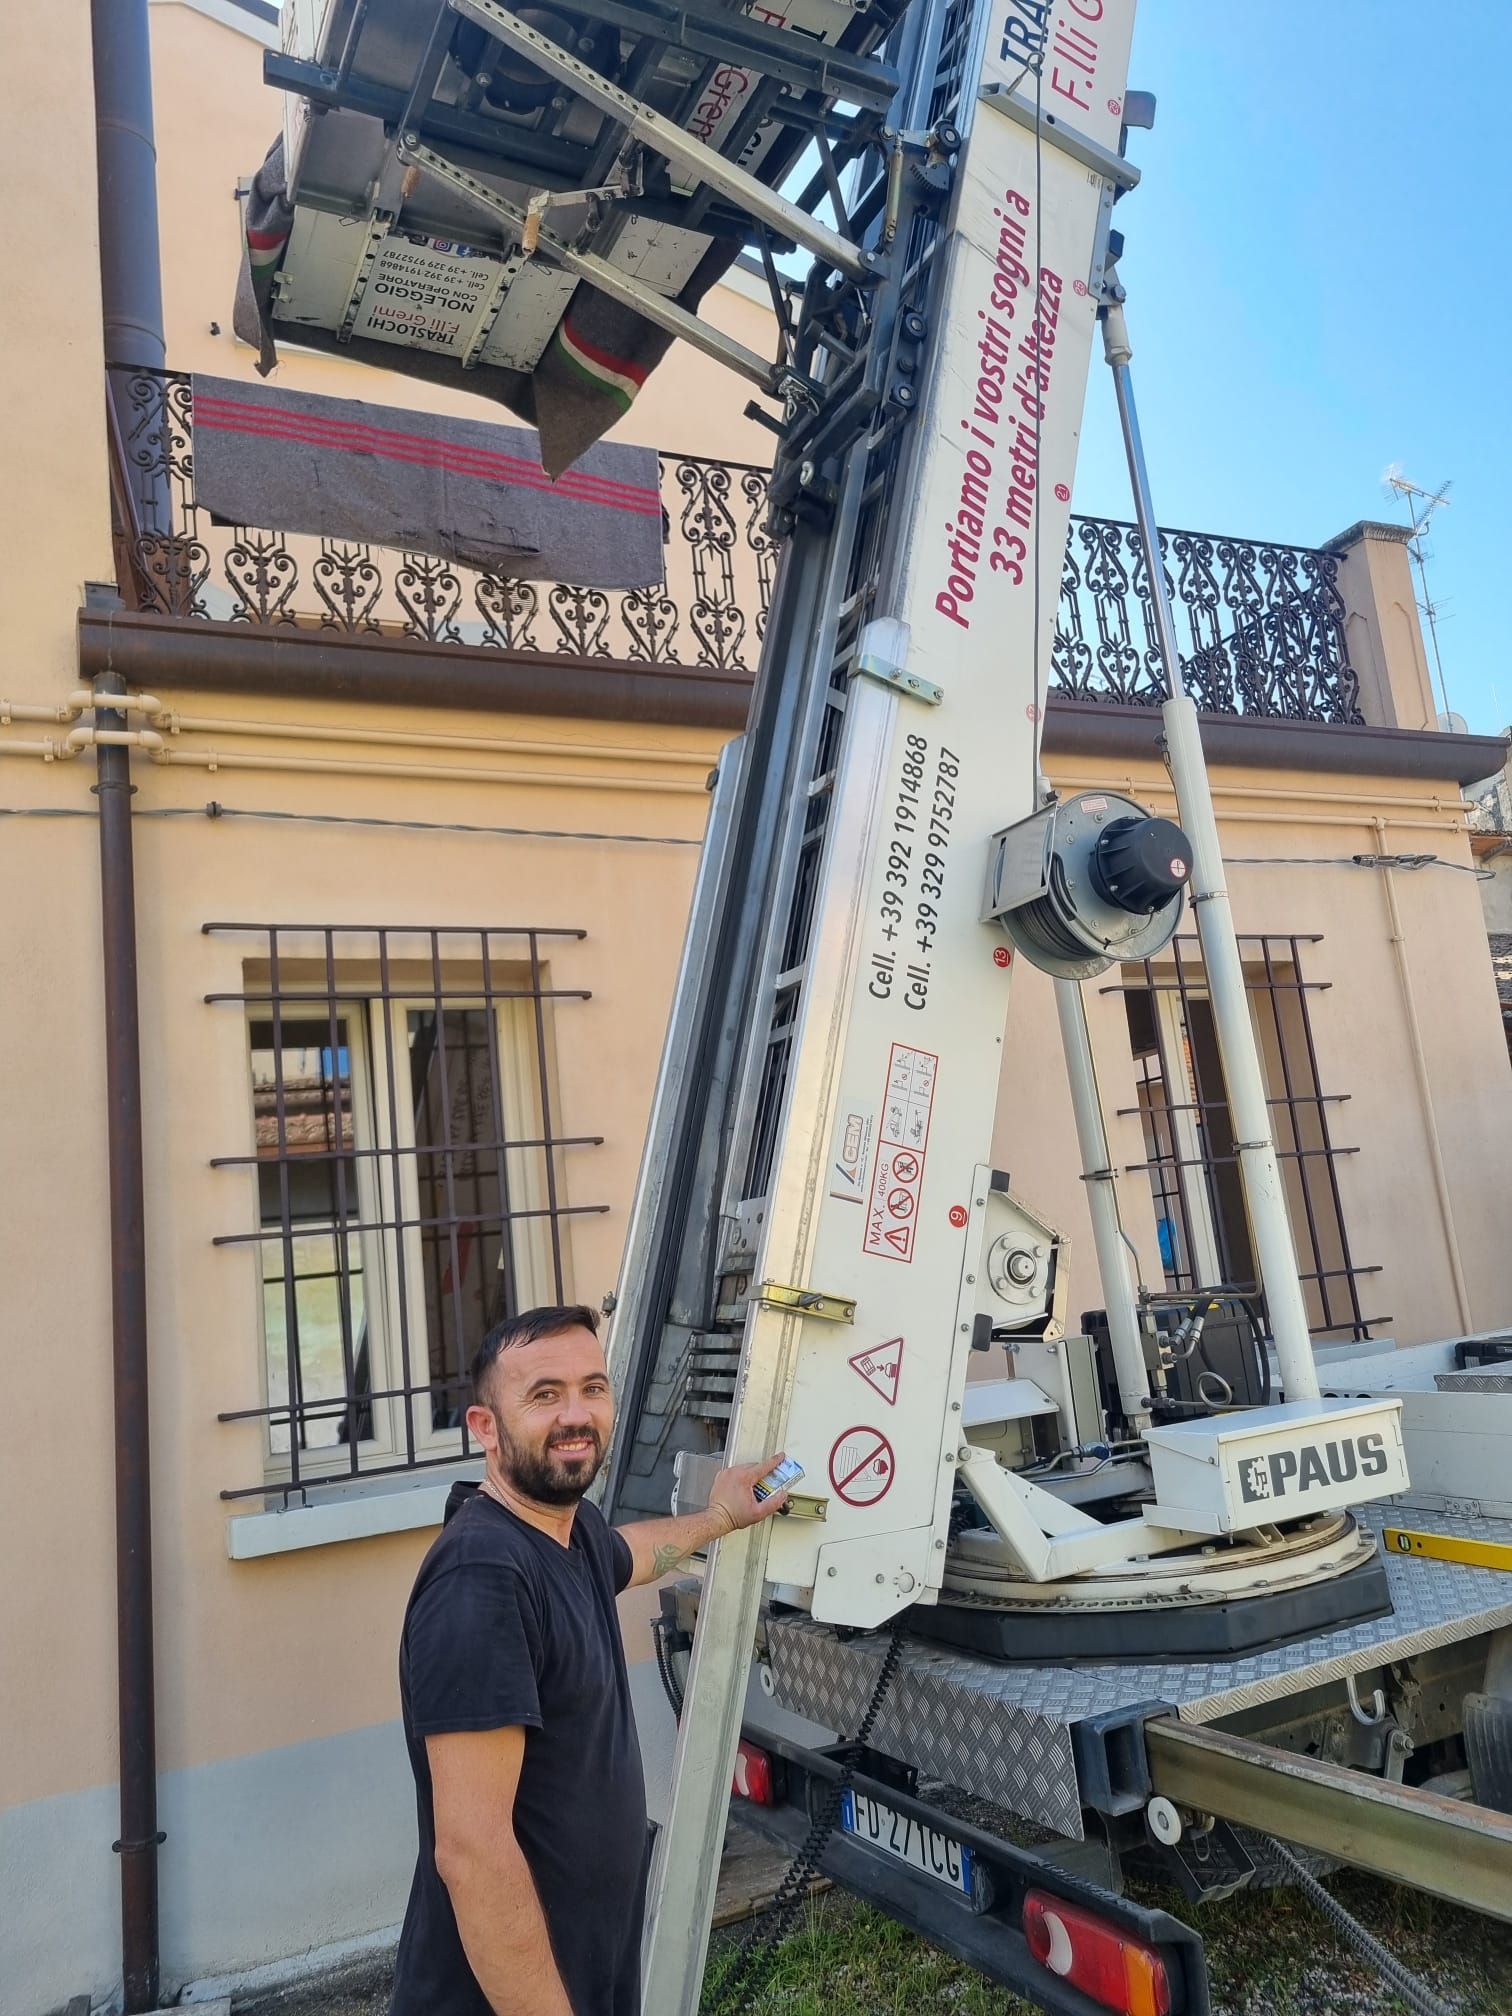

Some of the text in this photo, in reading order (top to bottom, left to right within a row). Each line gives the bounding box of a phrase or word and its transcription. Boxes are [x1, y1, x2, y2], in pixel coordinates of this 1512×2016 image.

[1000, 0, 1050, 77] TRA
[377, 273, 478, 302] CON OPERATORE
[380, 259, 485, 291] Cell. +39 392 1914868
[383, 249, 489, 281] Cell. +39 329 9752787
[373, 304, 426, 326] Gremi
[374, 282, 475, 313] NOLEGGIO
[367, 316, 455, 345] TRASLOCHI
[935, 189, 1030, 629] Portiamo i vostri sogni a
[989, 267, 1063, 585] 33 metri d'altezza
[868, 734, 928, 1000] Cell. +39 392 1914868
[904, 747, 960, 1011] Cell. +39 329 9752787
[843, 1114, 863, 1163] CEM
[870, 1163, 889, 1245] MAX. 400KG
[1267, 1433, 1388, 1497] PAUS
